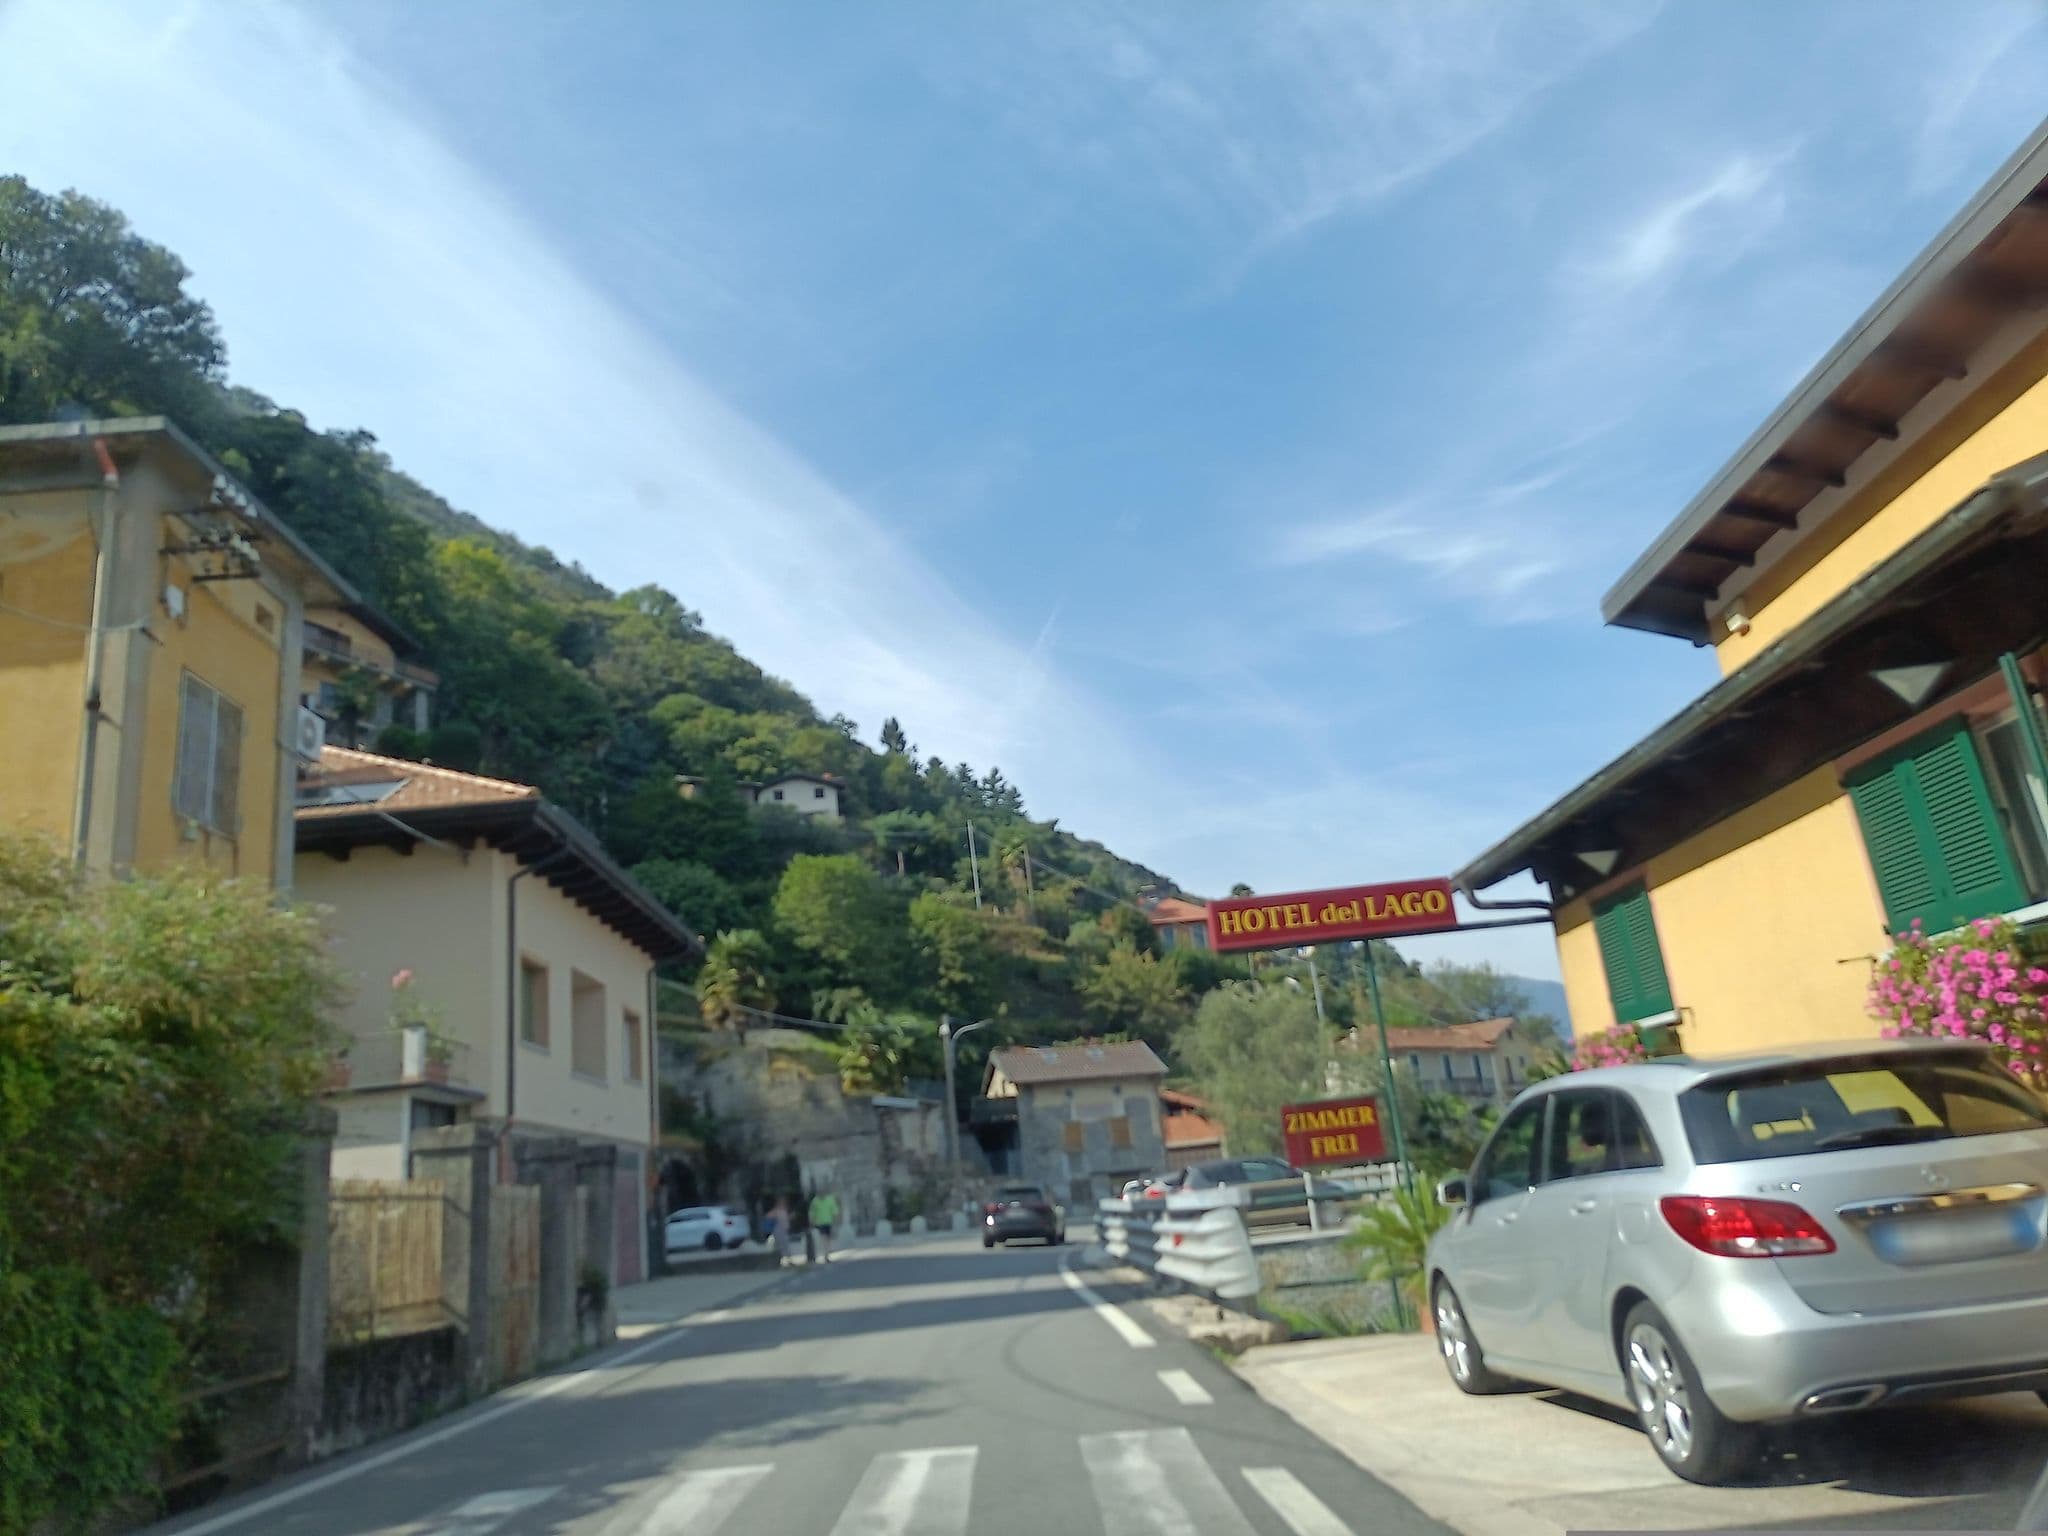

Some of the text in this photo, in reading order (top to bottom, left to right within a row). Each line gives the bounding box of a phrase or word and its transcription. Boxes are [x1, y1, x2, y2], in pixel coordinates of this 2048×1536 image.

[1218, 889, 1447, 935] HOTEL del LAGO
[1285, 1105, 1375, 1134] ZIMMER
[1310, 1133, 1359, 1158] FREI
